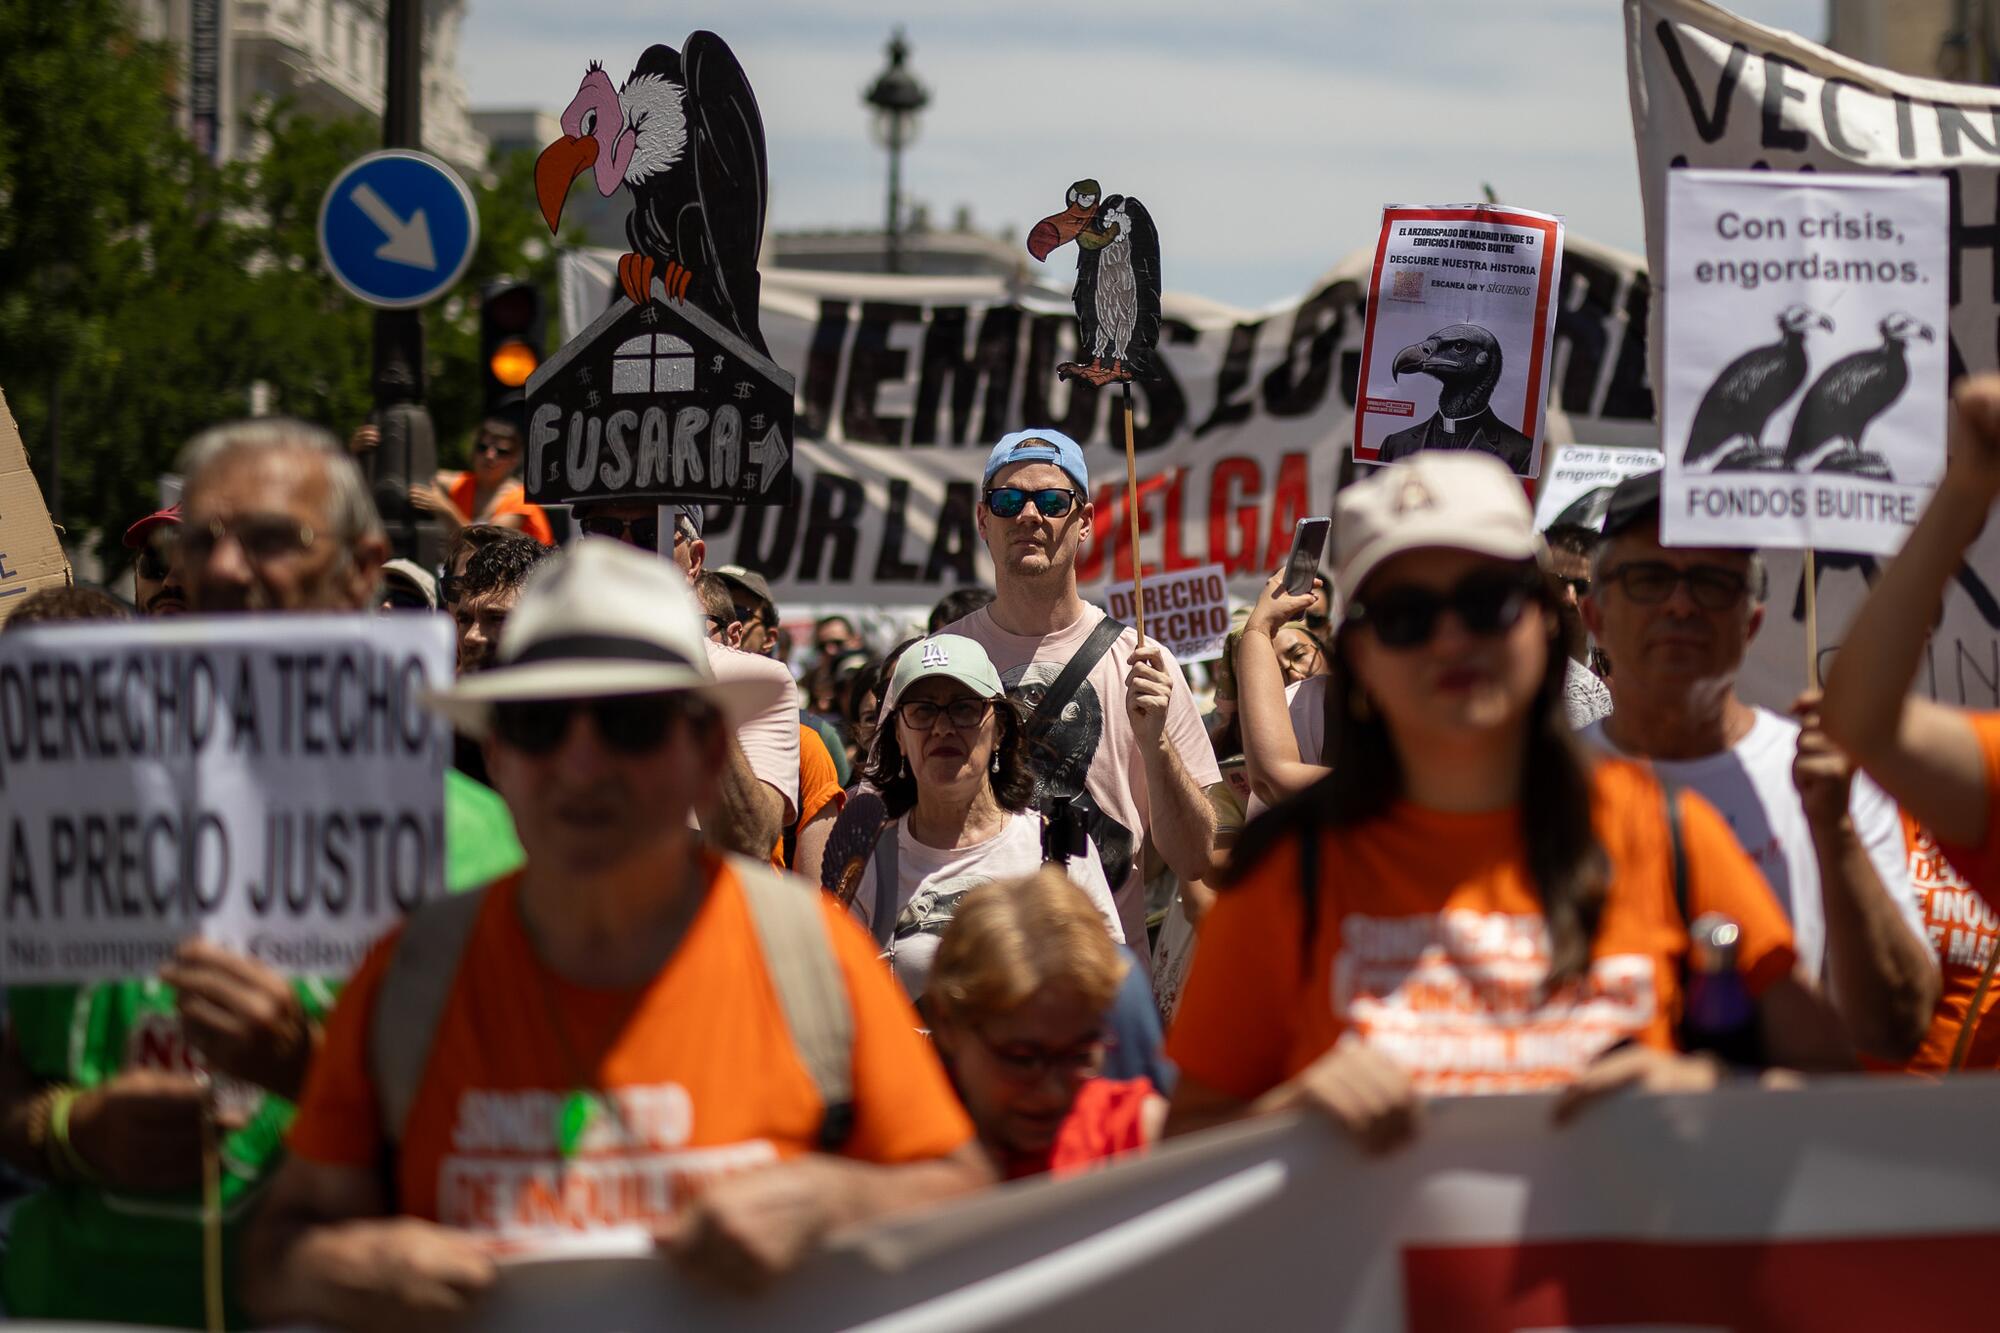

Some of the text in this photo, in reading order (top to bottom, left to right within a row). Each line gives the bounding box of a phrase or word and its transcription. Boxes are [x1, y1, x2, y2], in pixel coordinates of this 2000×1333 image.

[1399, 228, 1535, 245] EL ARZOBISPADO DE MADRID VENDE 13
[1717, 211, 1905, 245] Con crisis,
[1413, 238, 1515, 254] EDIFICIOS A FONDOS BUITRE
[1390, 255, 1537, 276] DESCUBRE NUESTRA HISTORIA
[1695, 254, 1929, 290] engordamos.
[1431, 280, 1465, 290] ESCANEA
[527, 403, 743, 496] FUSARA
[1564, 450, 1594, 462] Con
[1687, 487, 1918, 527] FONDOS BUITRE
[875, 478, 979, 583] LA
[923, 643, 949, 669] LA
[233, 654, 263, 752] A
[5, 818, 38, 920] A
[50, 811, 231, 918] PRECIO
